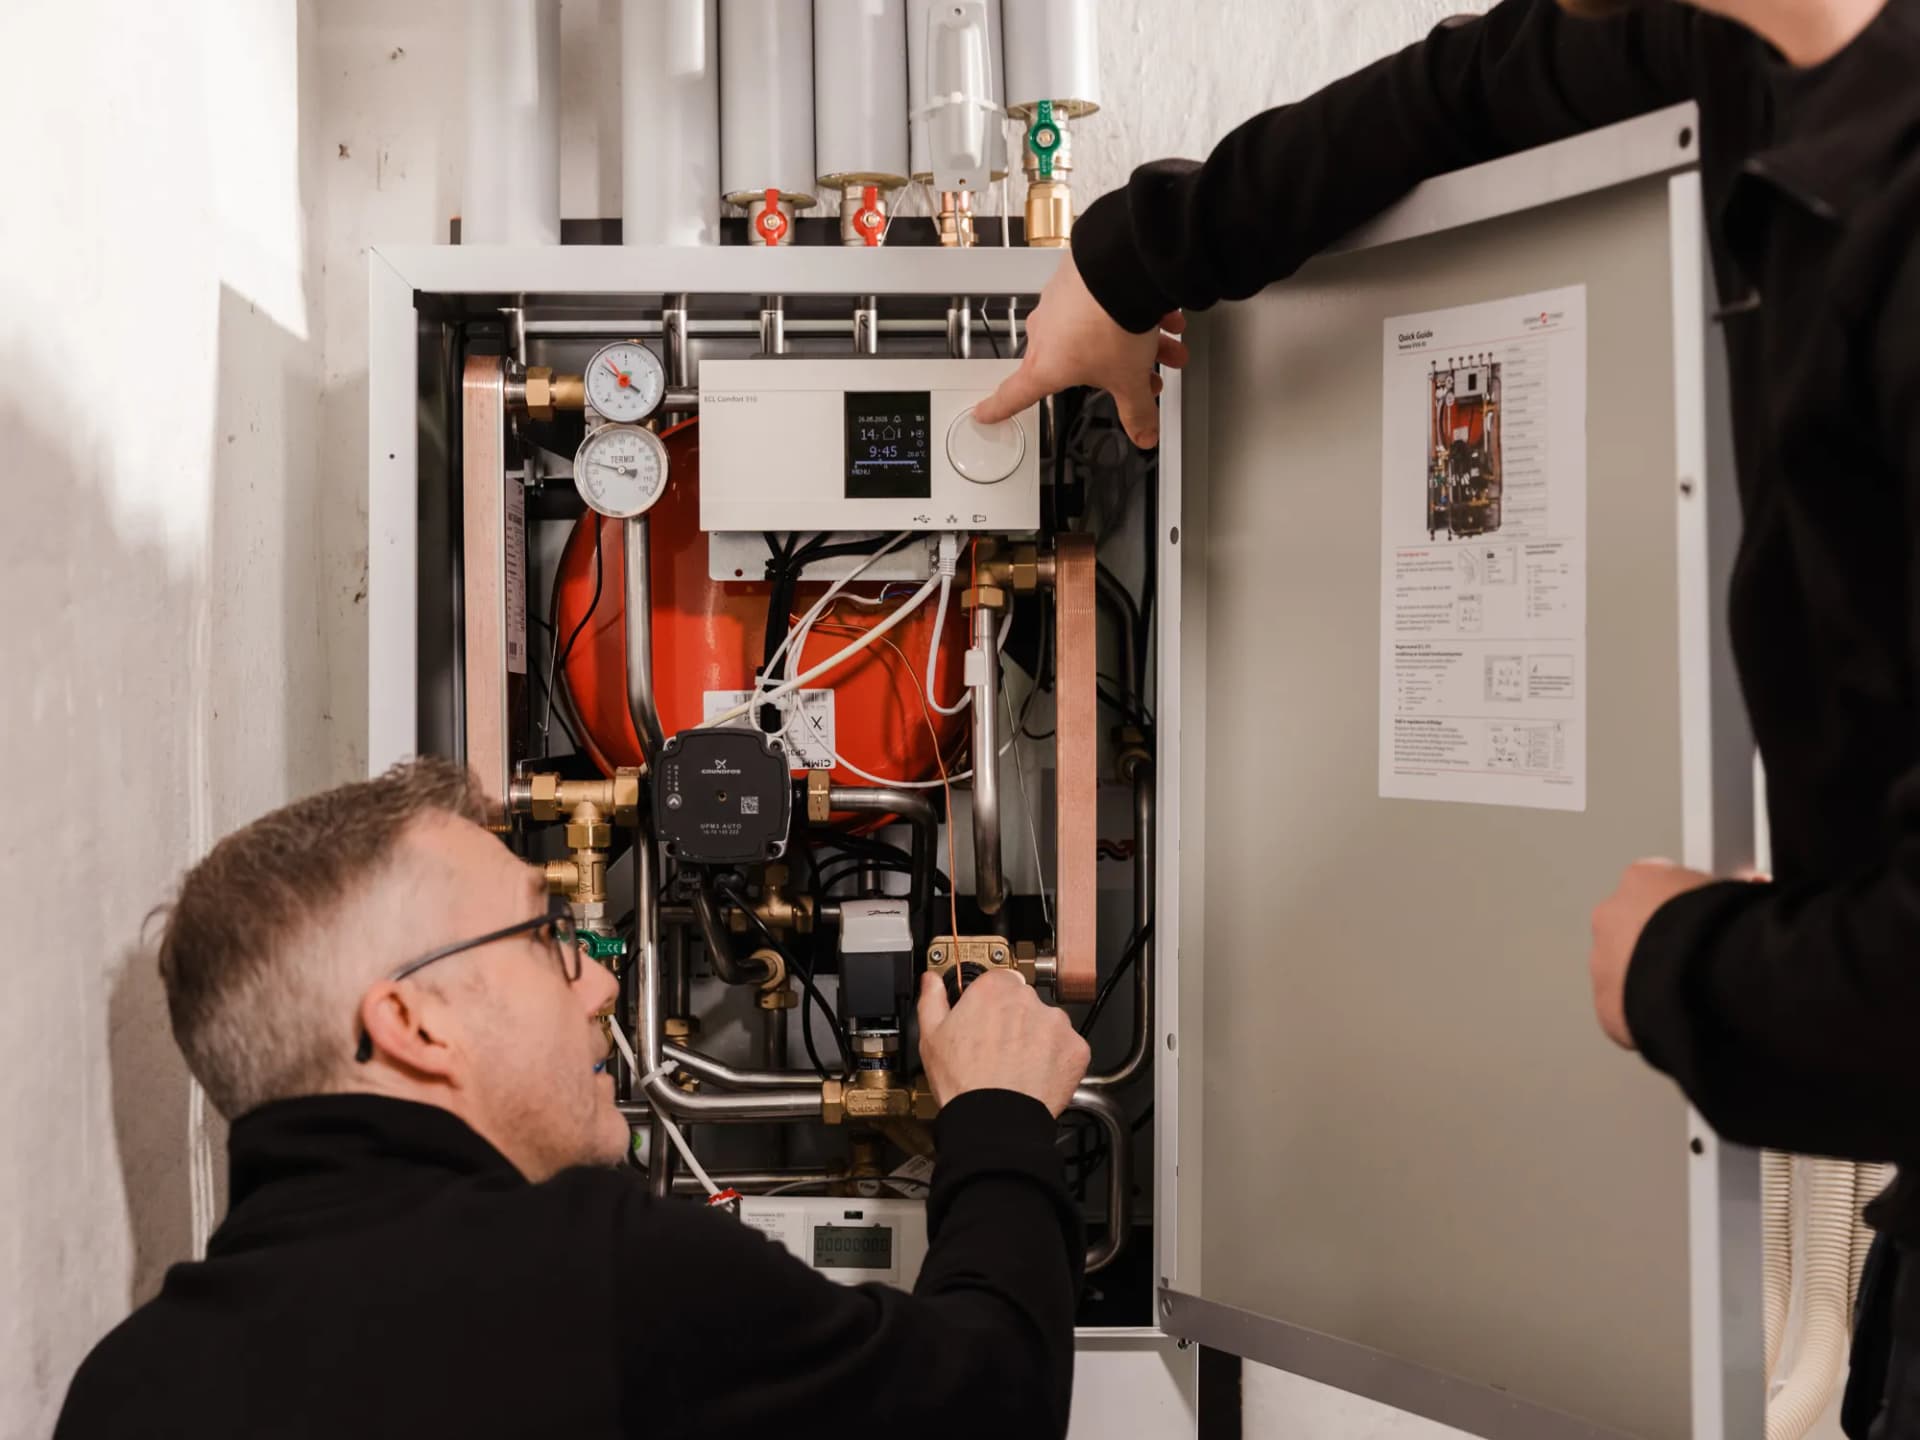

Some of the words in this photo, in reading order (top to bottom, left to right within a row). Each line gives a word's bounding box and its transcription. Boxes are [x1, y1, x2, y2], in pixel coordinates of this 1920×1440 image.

[1398, 332, 1415, 343] Quick
[1416, 330, 1433, 339] Guide
[717, 395, 744, 403] Comfort
[869, 445, 898, 458] 9:45
[802, 759, 831, 768] CIMM
